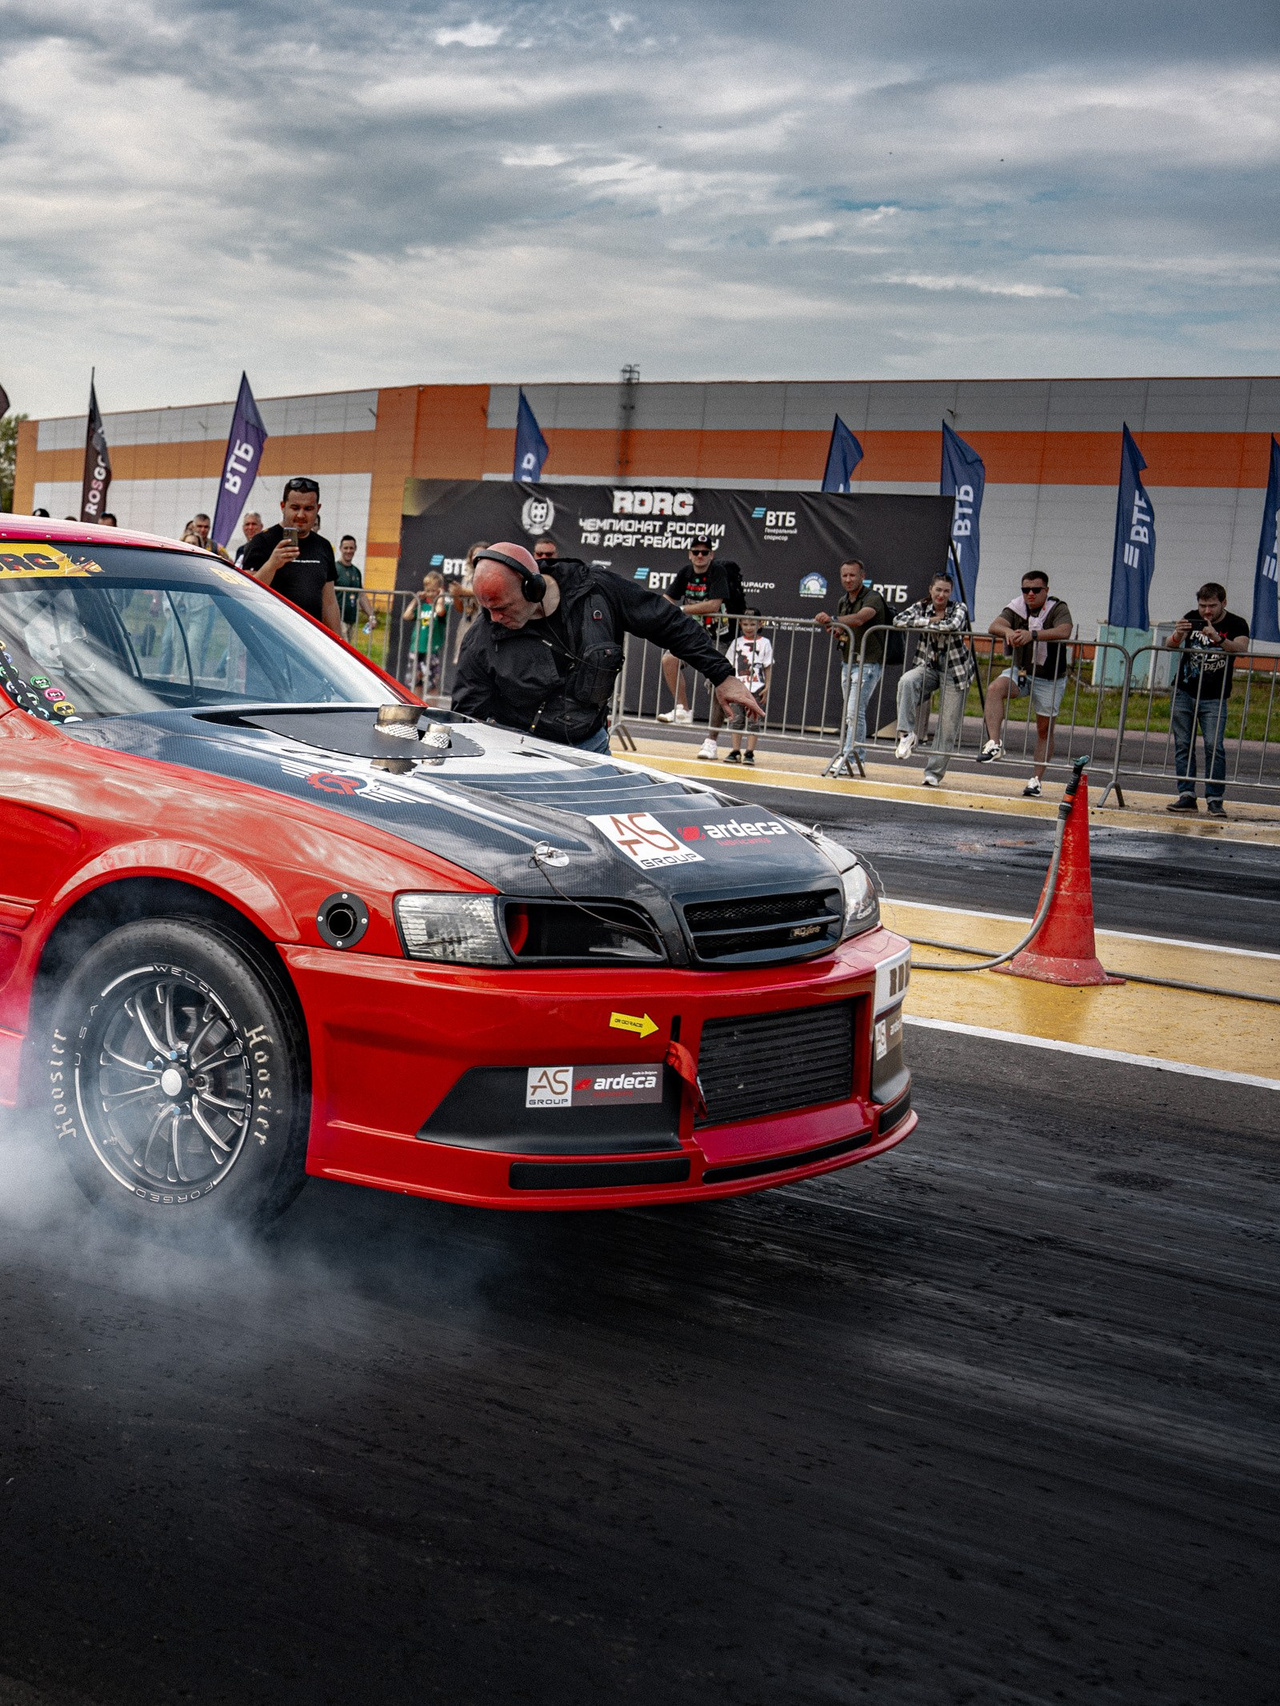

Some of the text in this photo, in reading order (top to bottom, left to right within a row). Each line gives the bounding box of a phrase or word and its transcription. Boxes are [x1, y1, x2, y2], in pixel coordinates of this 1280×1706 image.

[224, 438, 255, 494] ВТБ
[612, 490, 695, 516] RDRC
[953, 483, 974, 536] ВТБ
[579, 518, 725, 537] ЧЕМПИОНАТ РОССИИ
[765, 510, 796, 527] ВТБ
[580, 532, 720, 550] ПО ДРЭГ-РЕЙСИУ
[872, 583, 908, 603] ВТБ
[702, 818, 789, 840] ardeca
[640, 852, 697, 868] GROUP
[154, 964, 208, 993] WELD
[49, 1028, 77, 1140] Hoosier
[243, 1024, 283, 1146] Hoosier
[529, 1069, 570, 1096] AS
[593, 1073, 657, 1090] ardeca
[528, 1098, 569, 1106] GROUP
[135, 1181, 214, 1204] FORGED
